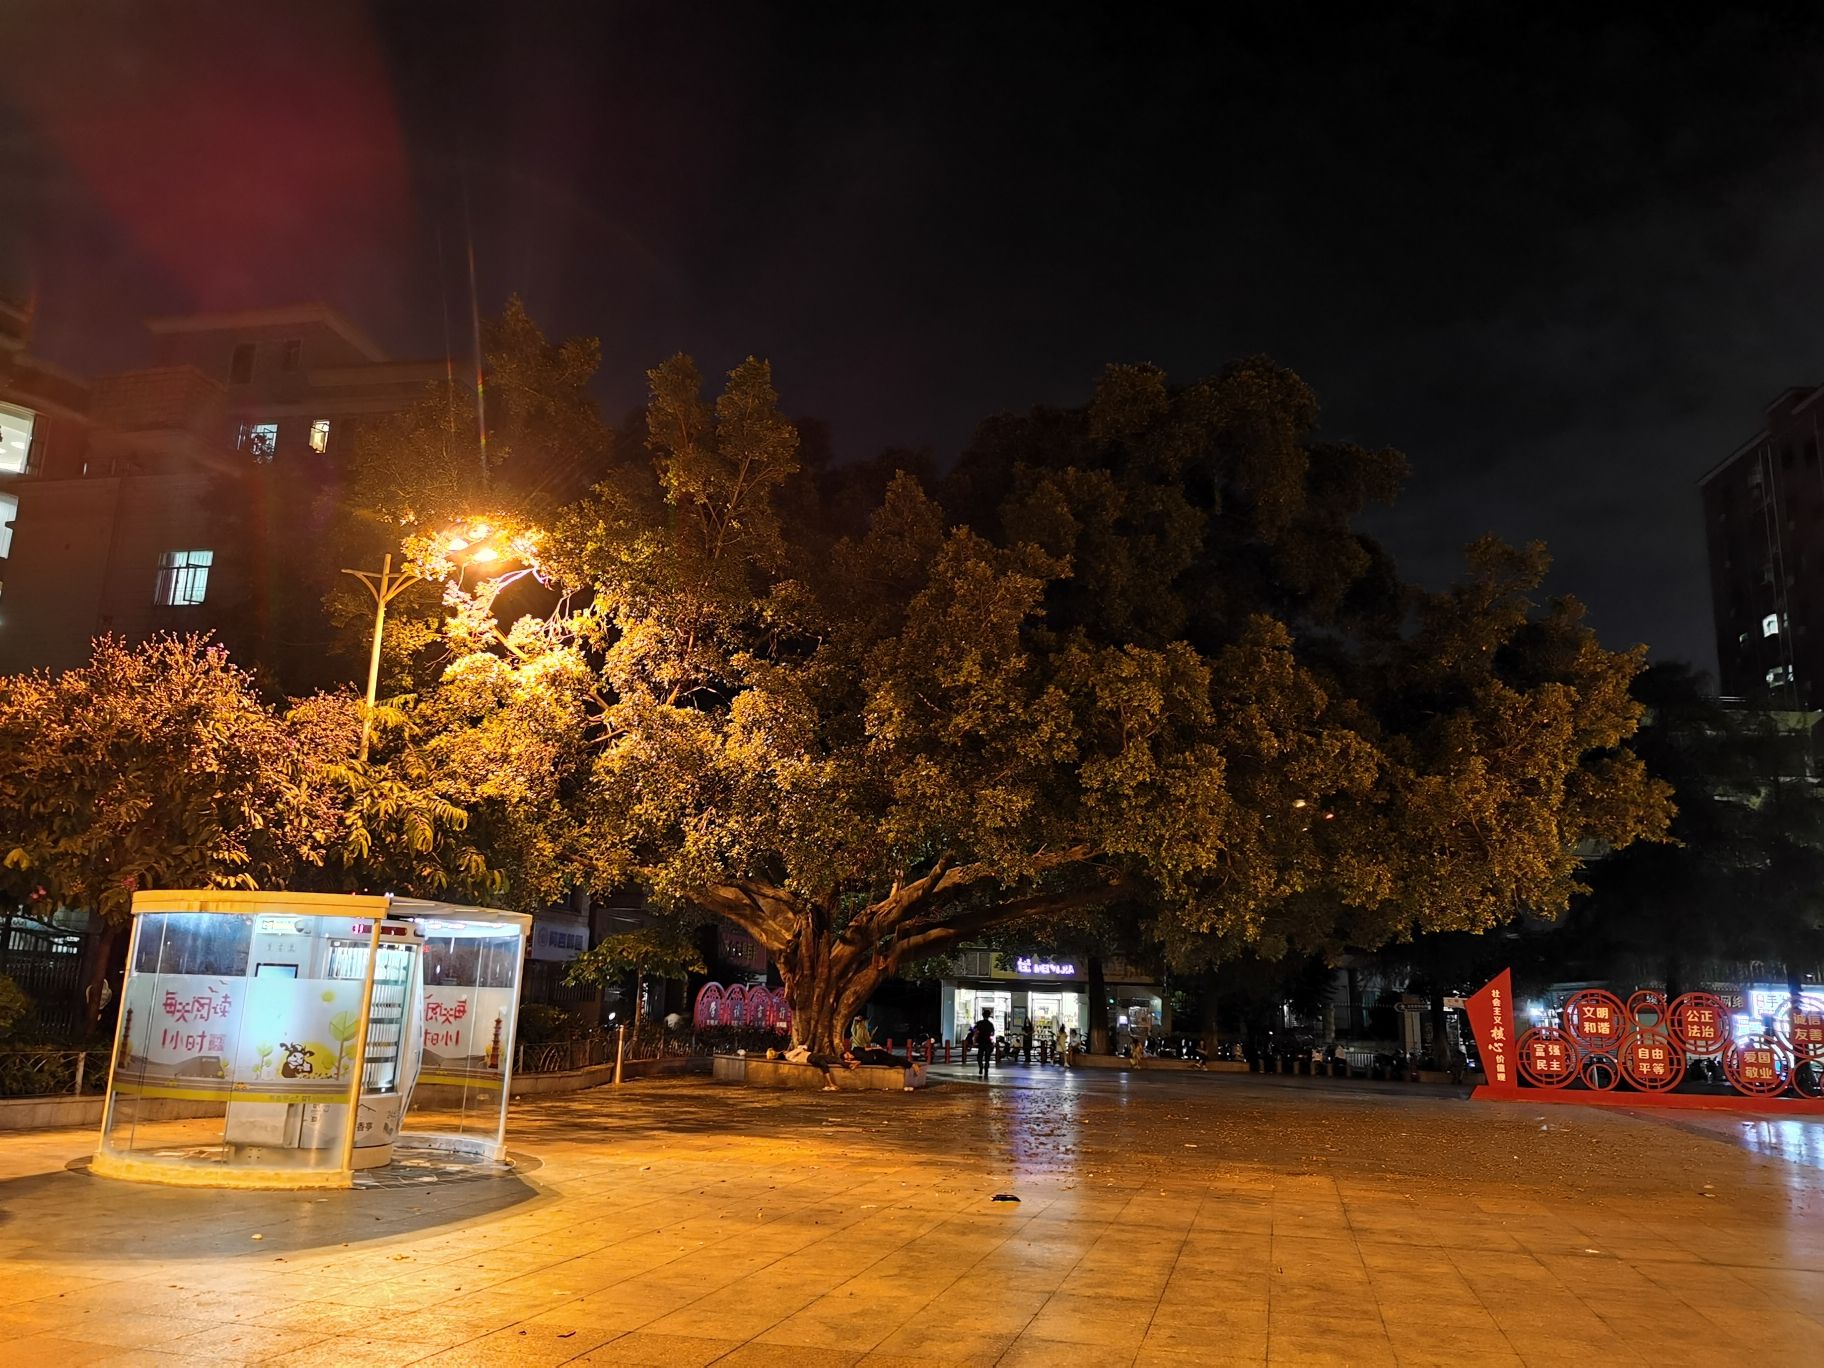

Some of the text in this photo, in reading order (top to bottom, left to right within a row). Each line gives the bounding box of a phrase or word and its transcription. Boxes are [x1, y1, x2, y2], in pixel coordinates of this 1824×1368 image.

[163, 990, 232, 1022] 每天阅读
[1583, 1007, 1609, 1019] 文明
[1686, 1010, 1713, 1022] 公正
[1793, 1013, 1820, 1025] 诚信
[1584, 1022, 1610, 1034] 和谐
[1688, 1025, 1714, 1037] 法治
[1795, 1029, 1822, 1040] 友善
[1534, 1044, 1561, 1056] 富强
[1638, 1048, 1663, 1060] 自由
[1744, 1052, 1770, 1063] 爱国
[1537, 1060, 1561, 1071] 民主
[1639, 1063, 1664, 1075] 平等
[1746, 1067, 1772, 1079] 敬业
